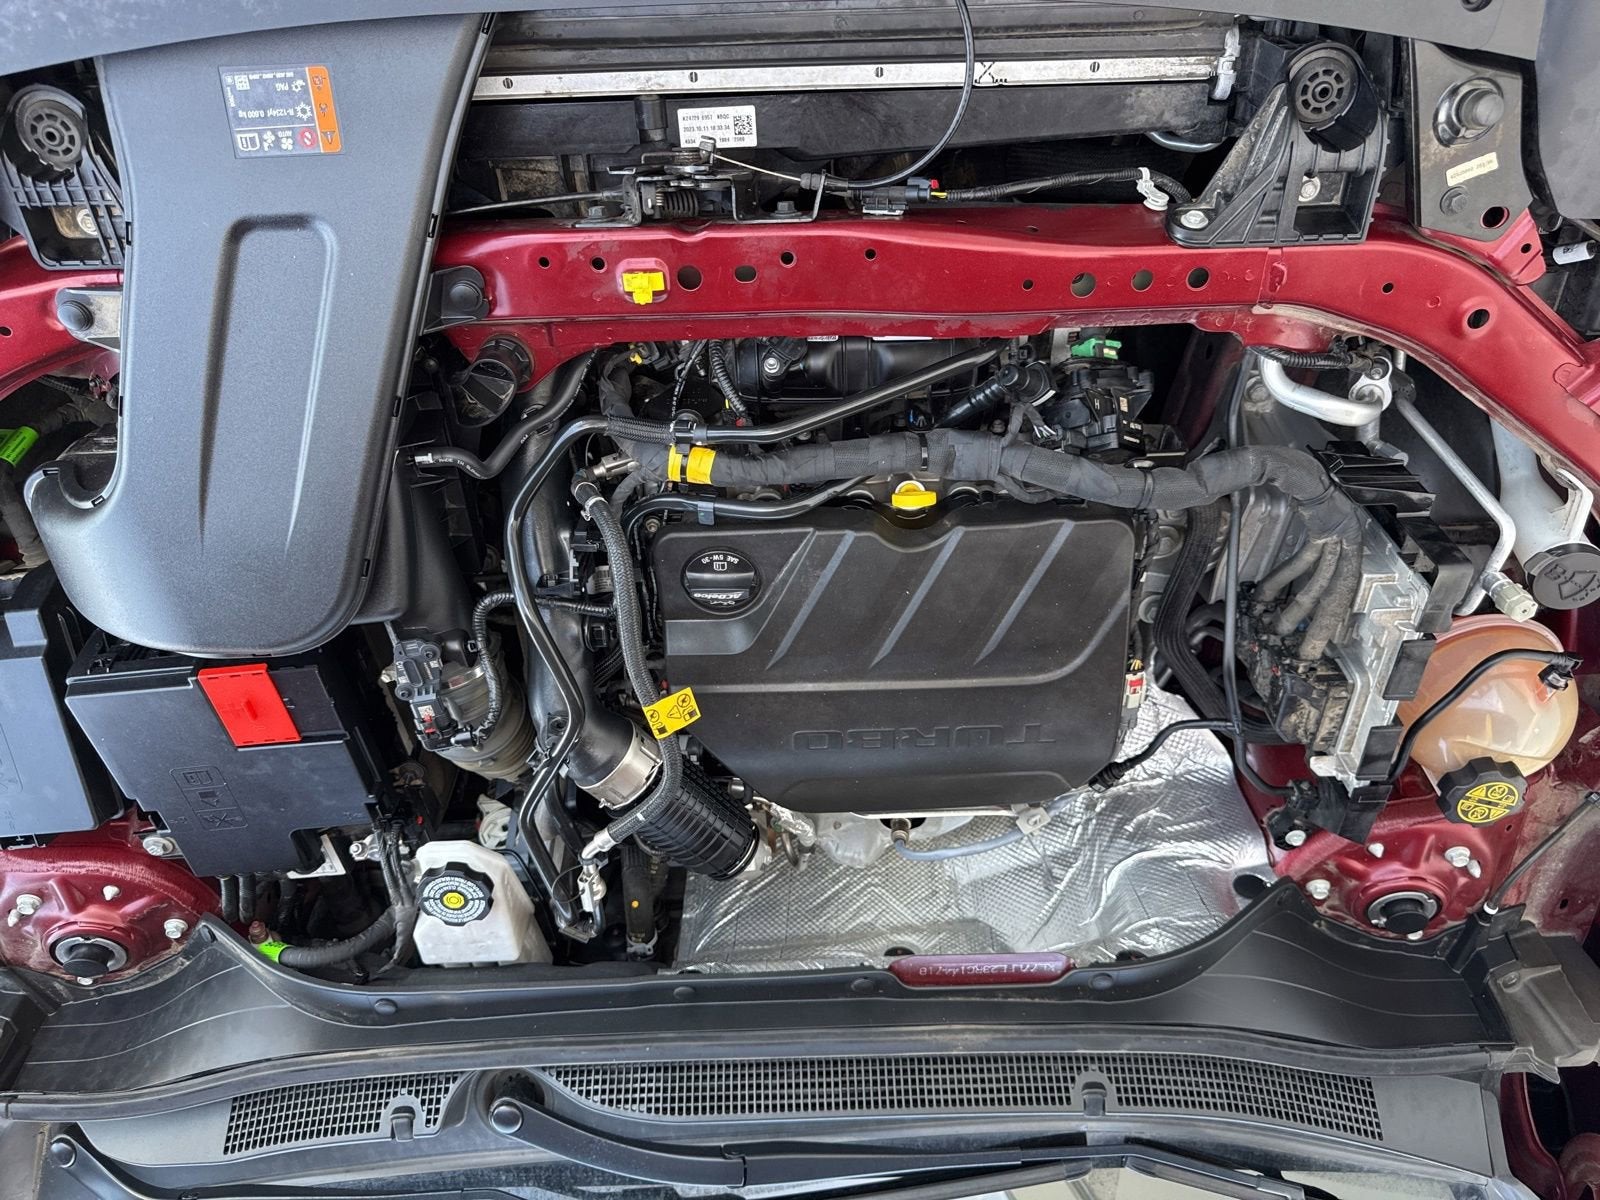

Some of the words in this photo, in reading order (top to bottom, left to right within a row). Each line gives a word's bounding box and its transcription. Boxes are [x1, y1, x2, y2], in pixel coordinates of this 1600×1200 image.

[275, 82, 289, 91] PAG
[278, 130, 293, 138] AUTO
[701, 554, 724, 564] 5W-30
[726, 555, 739, 564] SAE
[792, 723, 1056, 750] TURBO
